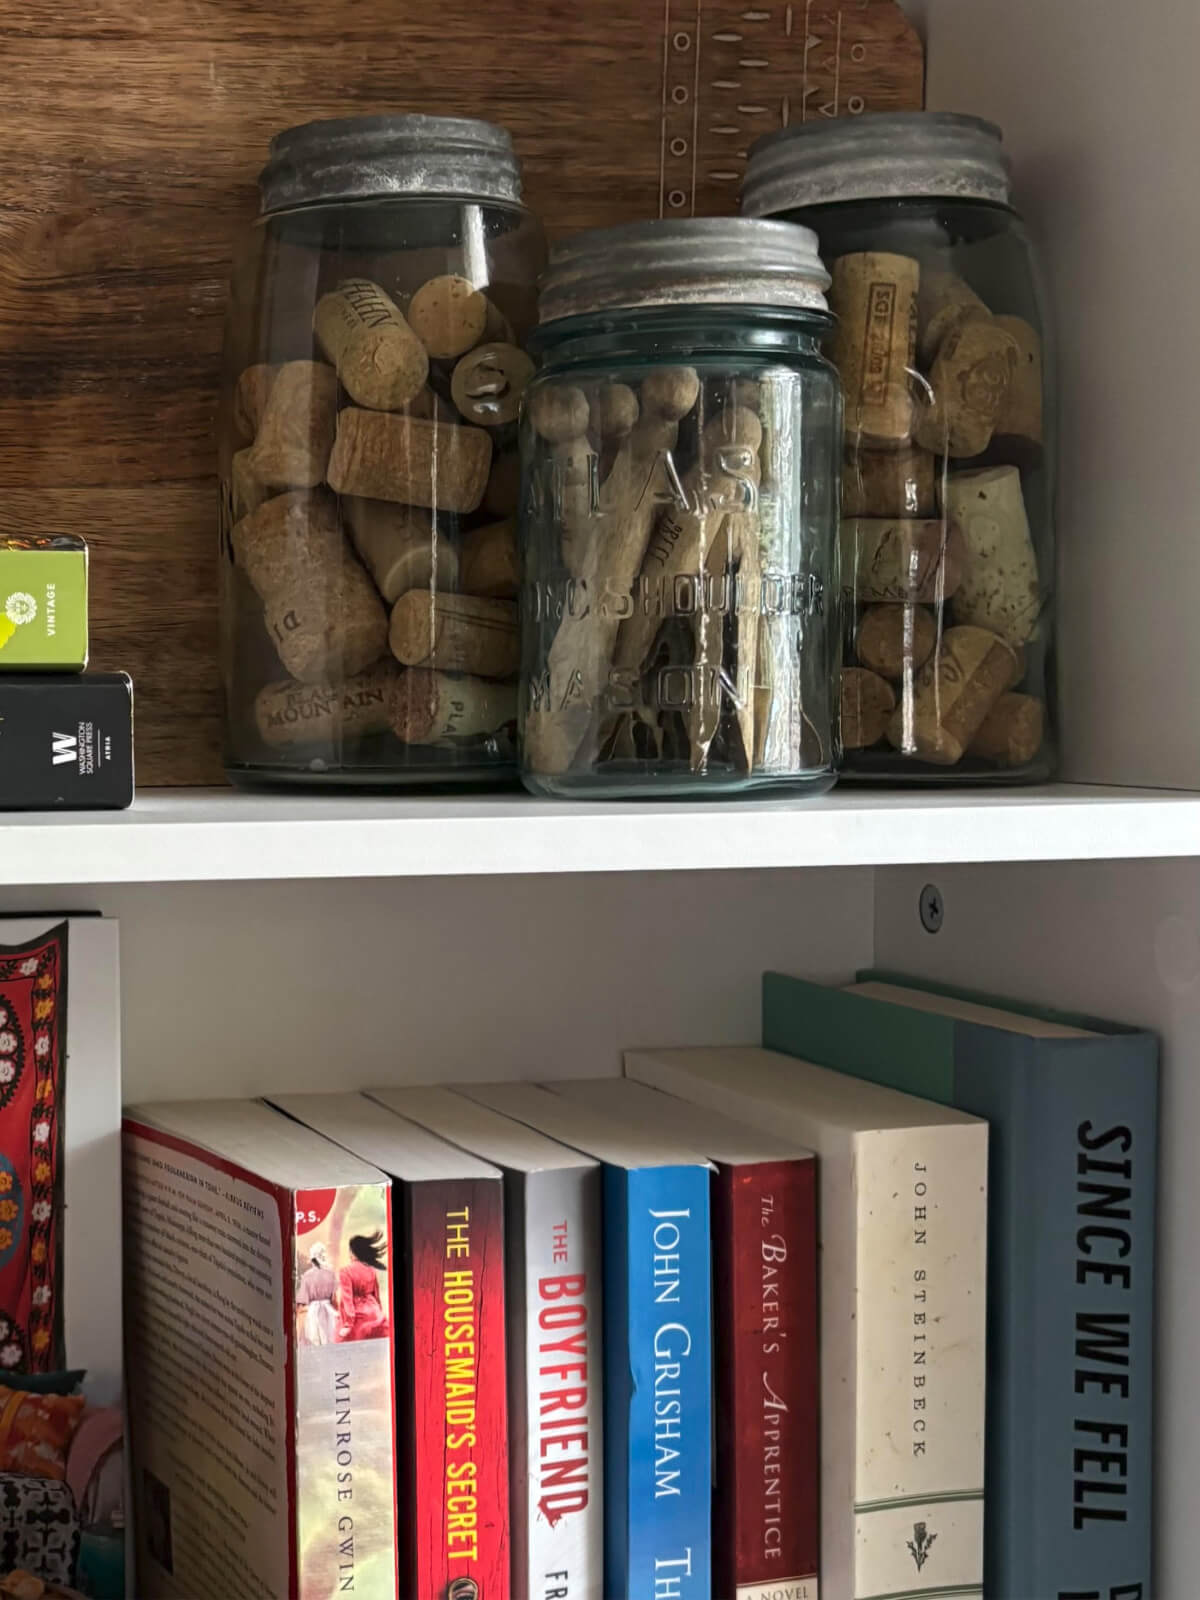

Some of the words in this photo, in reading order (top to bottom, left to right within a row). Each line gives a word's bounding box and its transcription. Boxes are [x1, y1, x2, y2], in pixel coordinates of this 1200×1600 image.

[342, 281, 399, 329] HAHN
[46, 583, 56, 637] VINTAGE
[78, 721, 86, 775] WASHINGTON
[85, 721, 94, 743] PRESS
[85, 744, 94, 775] SQUARE
[295, 1210, 321, 1223] P.S.
[446, 1206, 470, 1259] THE
[552, 1219, 568, 1264] THE
[760, 1194, 775, 1228] The
[913, 1162, 928, 1246] JOHN
[1075, 1119, 1133, 1289] SINCE
[648, 1207, 691, 1304] JOHN
[761, 1234, 788, 1354] BAKER'S
[443, 1270, 476, 1449] HOUSEMAID'S
[912, 1269, 928, 1458] STEINBECK
[1074, 1311, 1131, 1399] WE
[334, 1371, 352, 1502] MINROSE
[537, 1273, 589, 1528] BOYFRIEND
[654, 1322, 692, 1500] GRISHAM
[762, 1371, 790, 1560] APPRENTICE
[1072, 1418, 1129, 1531] FELL
[446, 1461, 478, 1562] SECRET
[338, 1516, 354, 1592] GWIN
[654, 1547, 692, 1600] TH
[761, 1585, 809, 1600] NOVEL
